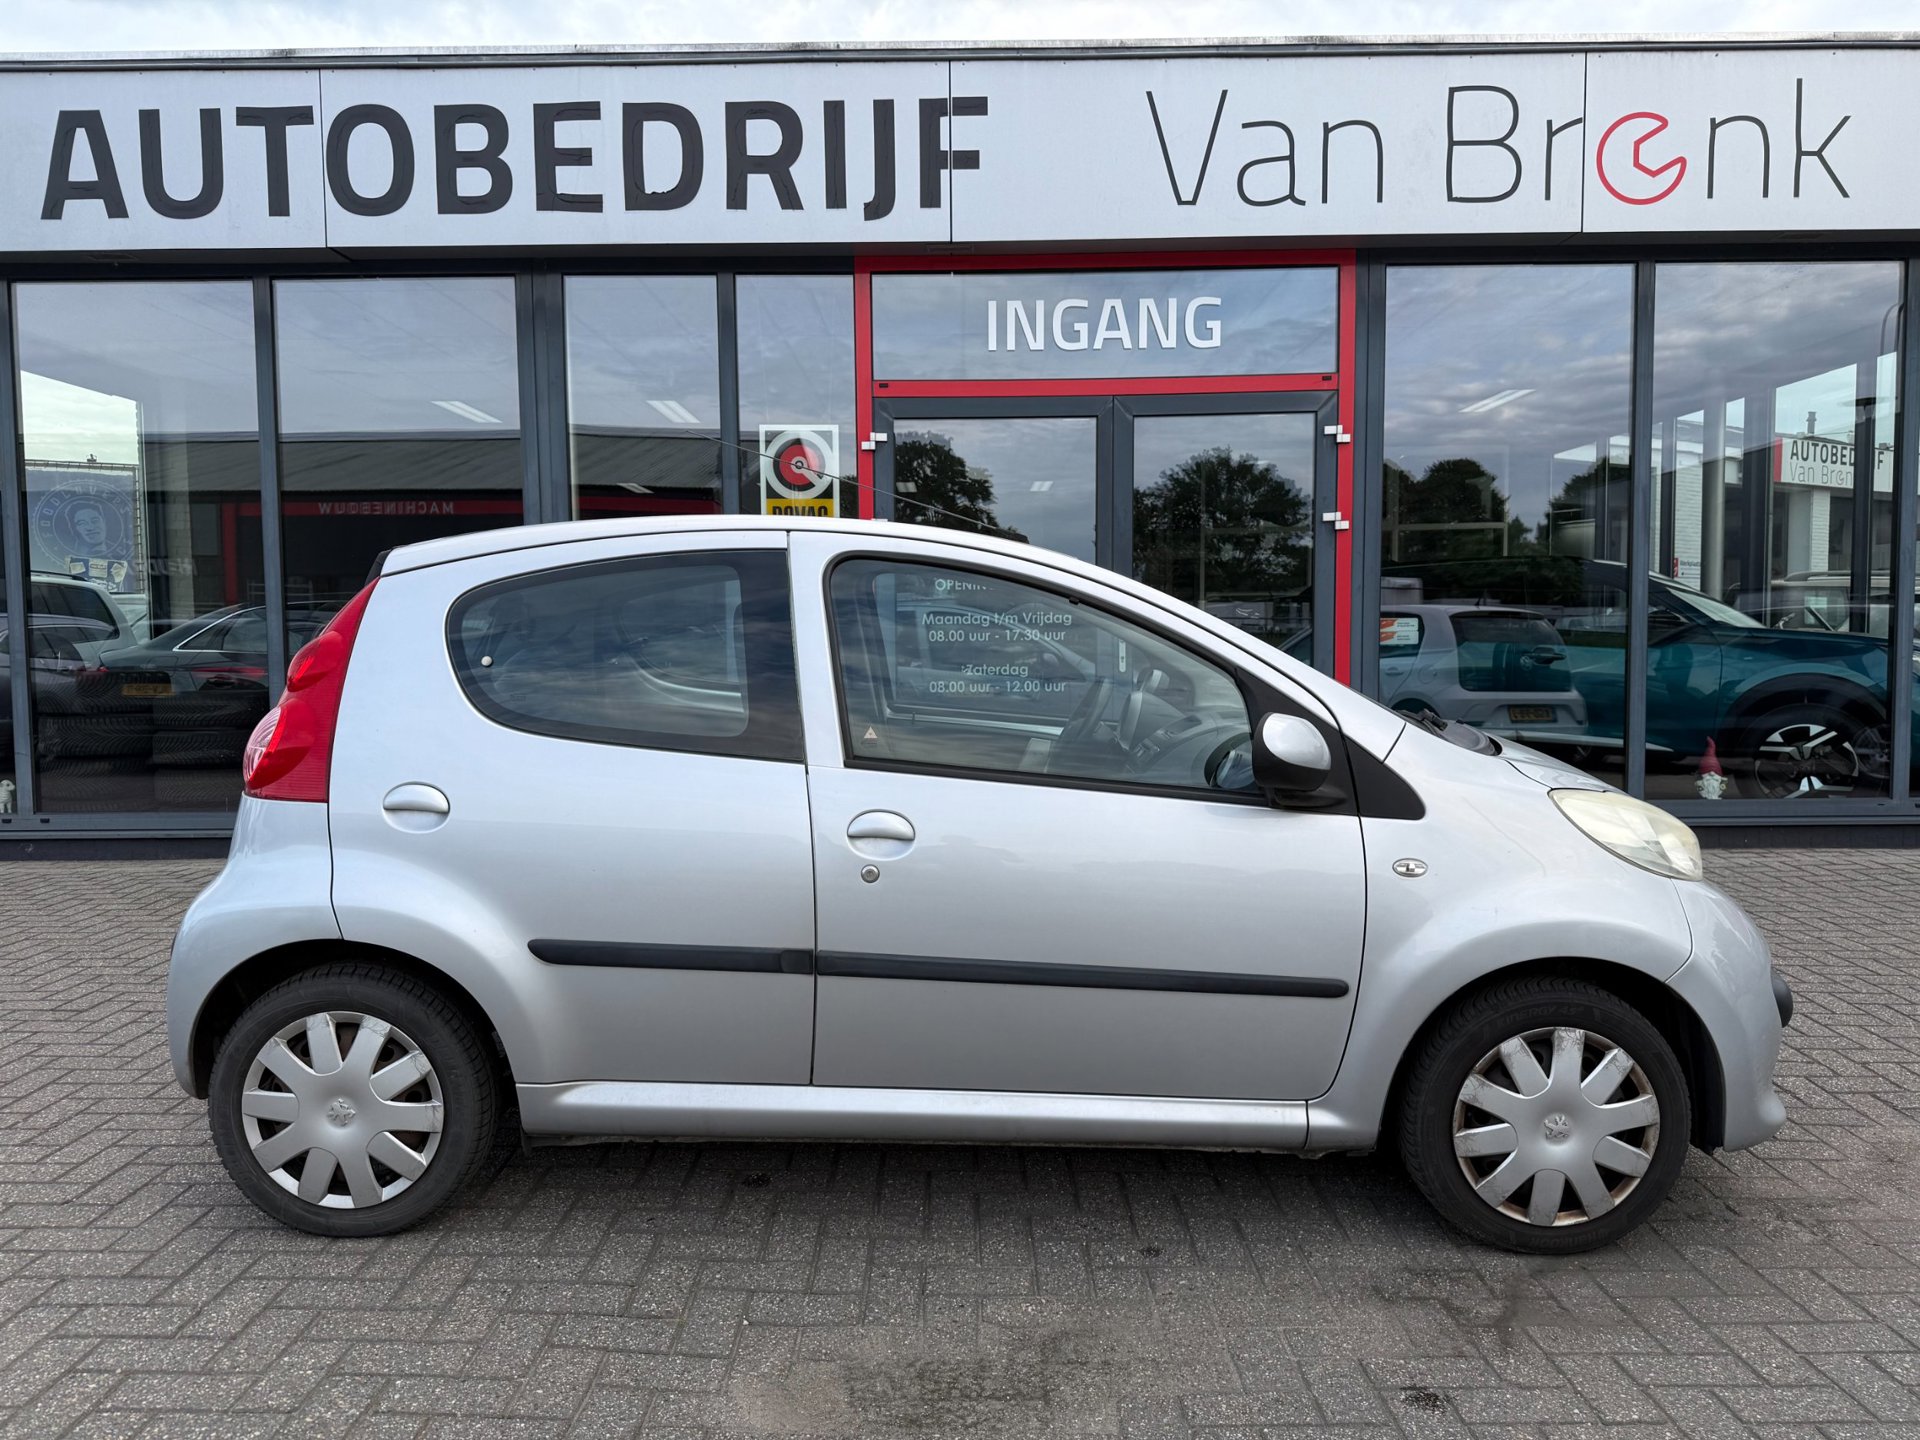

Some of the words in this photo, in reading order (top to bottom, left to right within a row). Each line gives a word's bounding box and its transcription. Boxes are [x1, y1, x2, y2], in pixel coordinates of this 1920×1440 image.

[1145, 88, 1383, 206] Van
[41, 96, 988, 222] AUTOBEDRIJF
[987, 296, 1223, 352] INGANG
[1790, 461, 1815, 483] Van
[922, 612, 990, 627] Maandag
[994, 612, 1018, 626] t/m
[1022, 611, 1073, 626] Vrijdag
[928, 629, 965, 642] 08.00
[968, 632, 991, 642] uur
[1005, 629, 1041, 641] 17.30
[1044, 630, 1067, 641] uur
[966, 664, 1029, 678] Zaterdag
[929, 681, 966, 693] 08.00
[969, 683, 992, 693] uur
[1005, 680, 1041, 692] 12.00
[1044, 682, 1067, 692] uur
